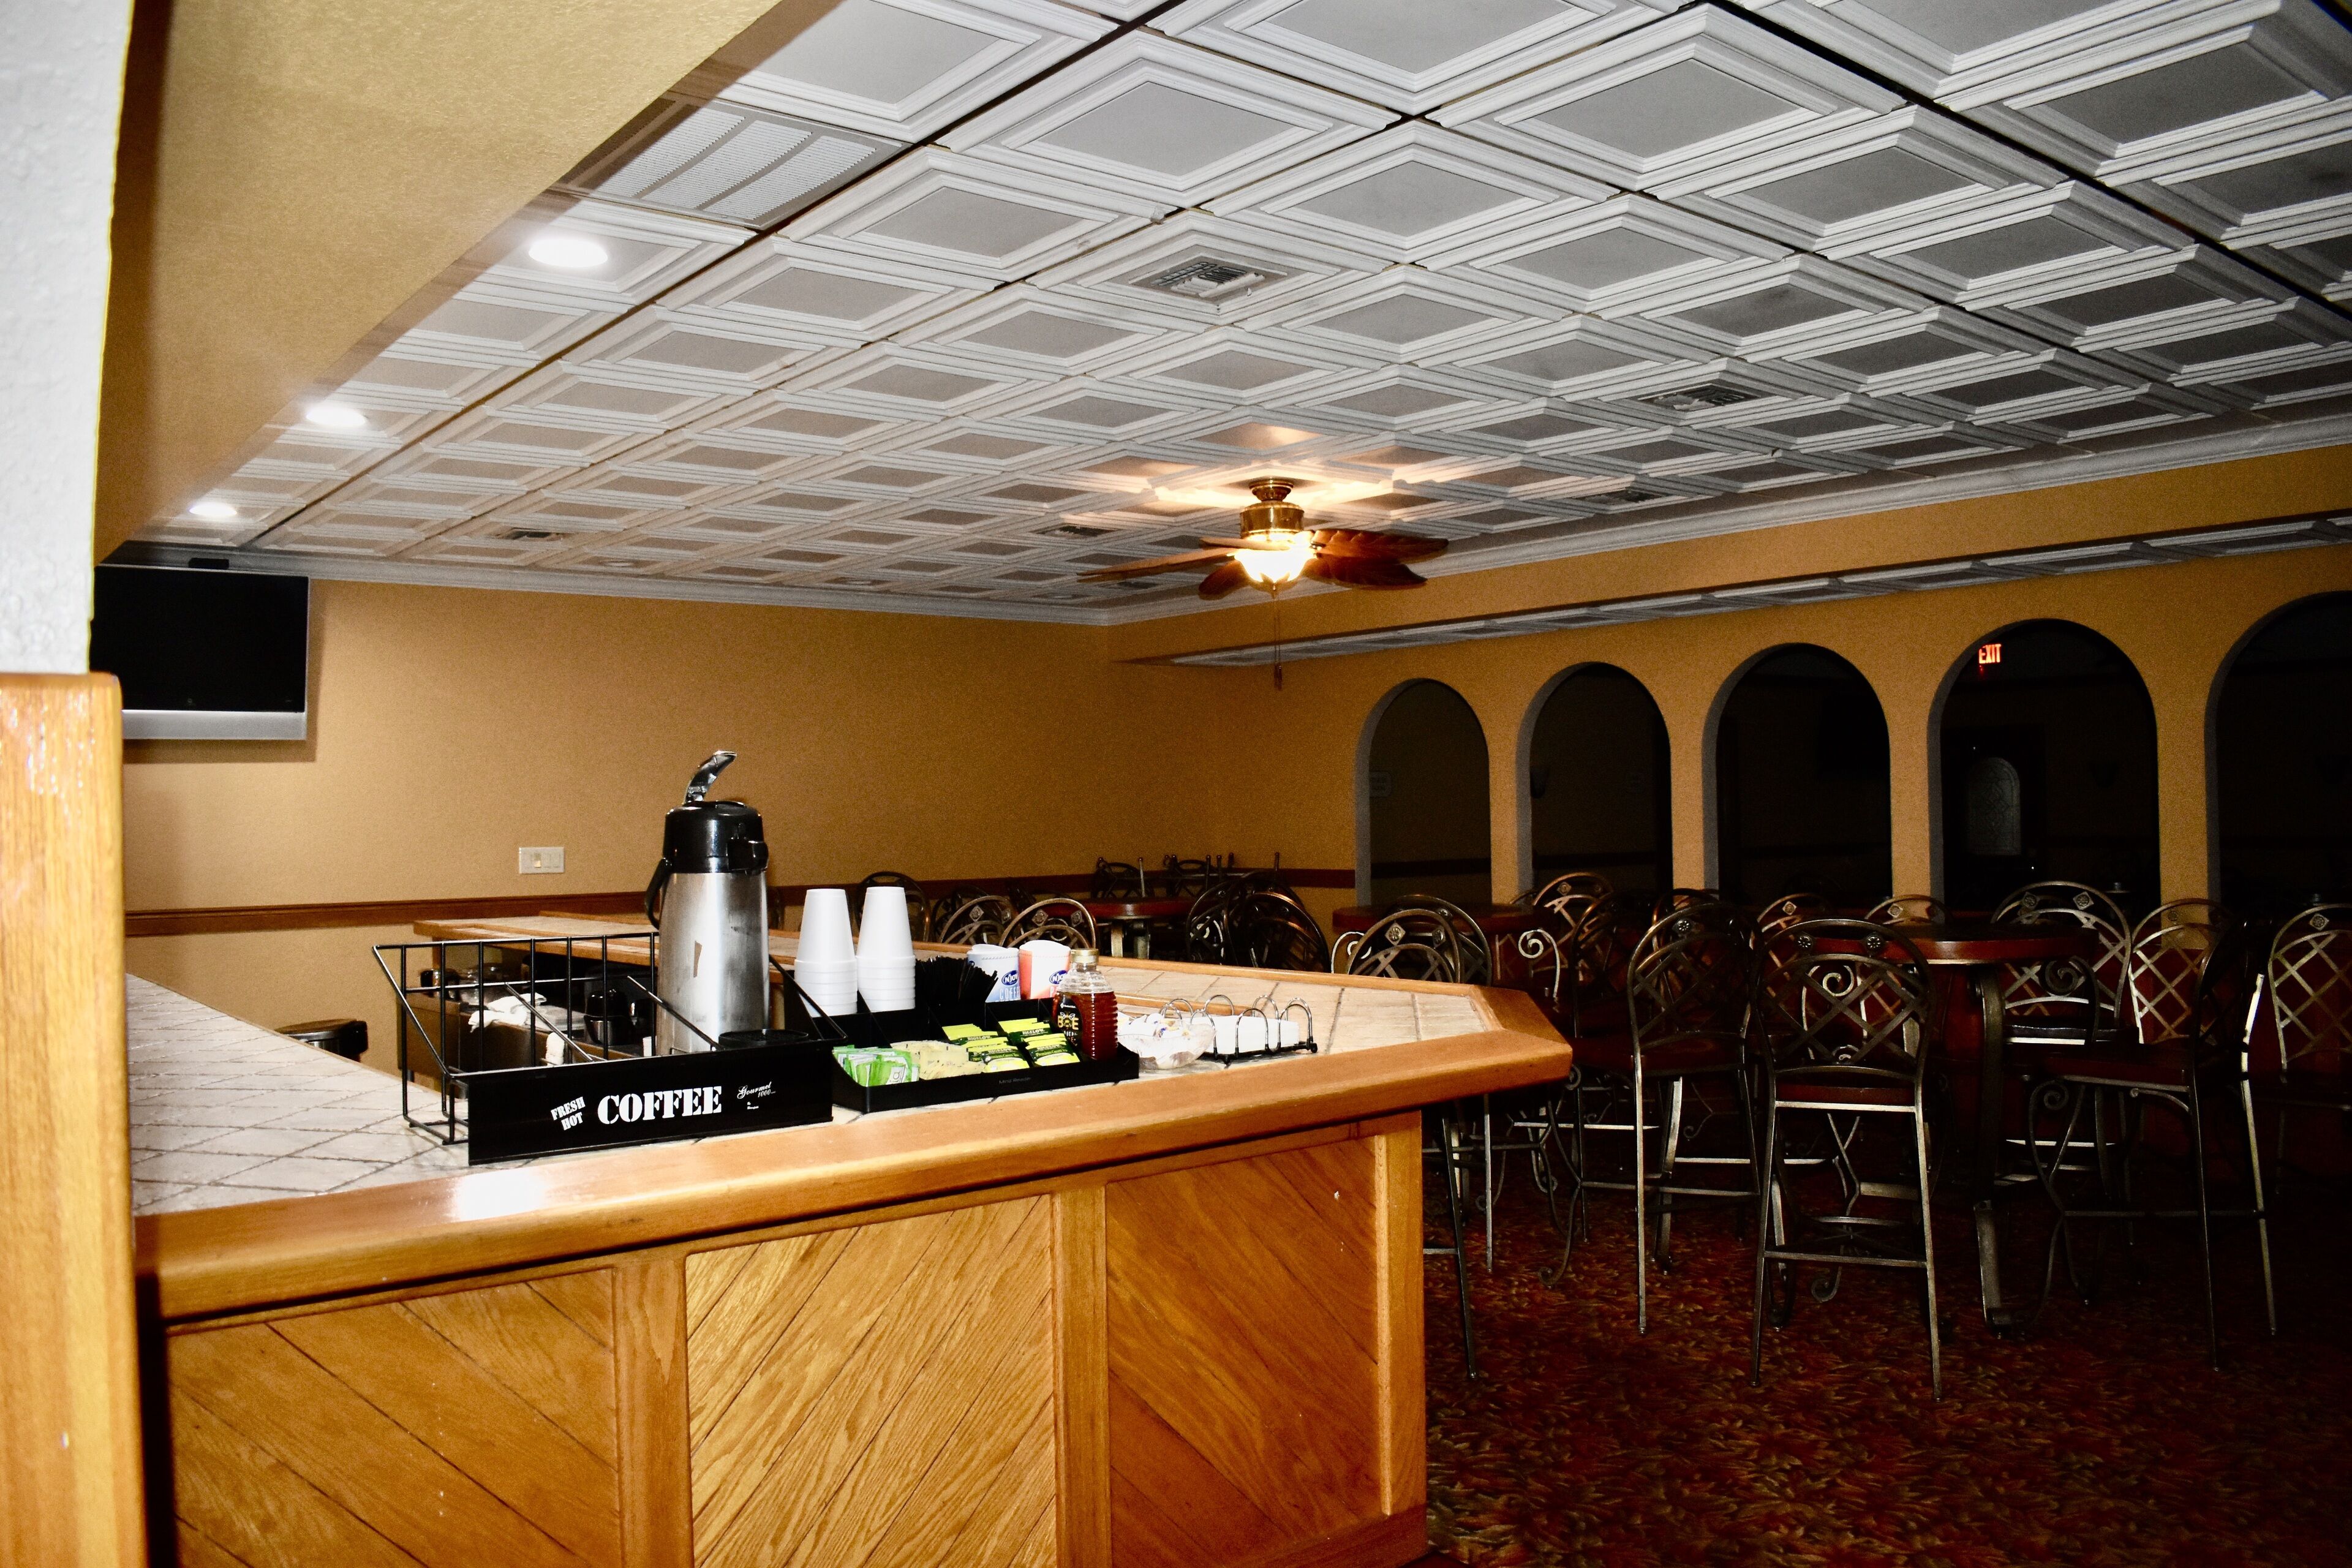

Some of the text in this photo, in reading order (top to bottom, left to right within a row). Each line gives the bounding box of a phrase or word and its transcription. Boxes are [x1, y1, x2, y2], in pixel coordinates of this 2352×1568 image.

[1978, 643, 2002, 664] EXIT
[551, 1096, 586, 1121] FRESH
[597, 1086, 722, 1125] COFFEE
[560, 1112, 583, 1131] HOT
